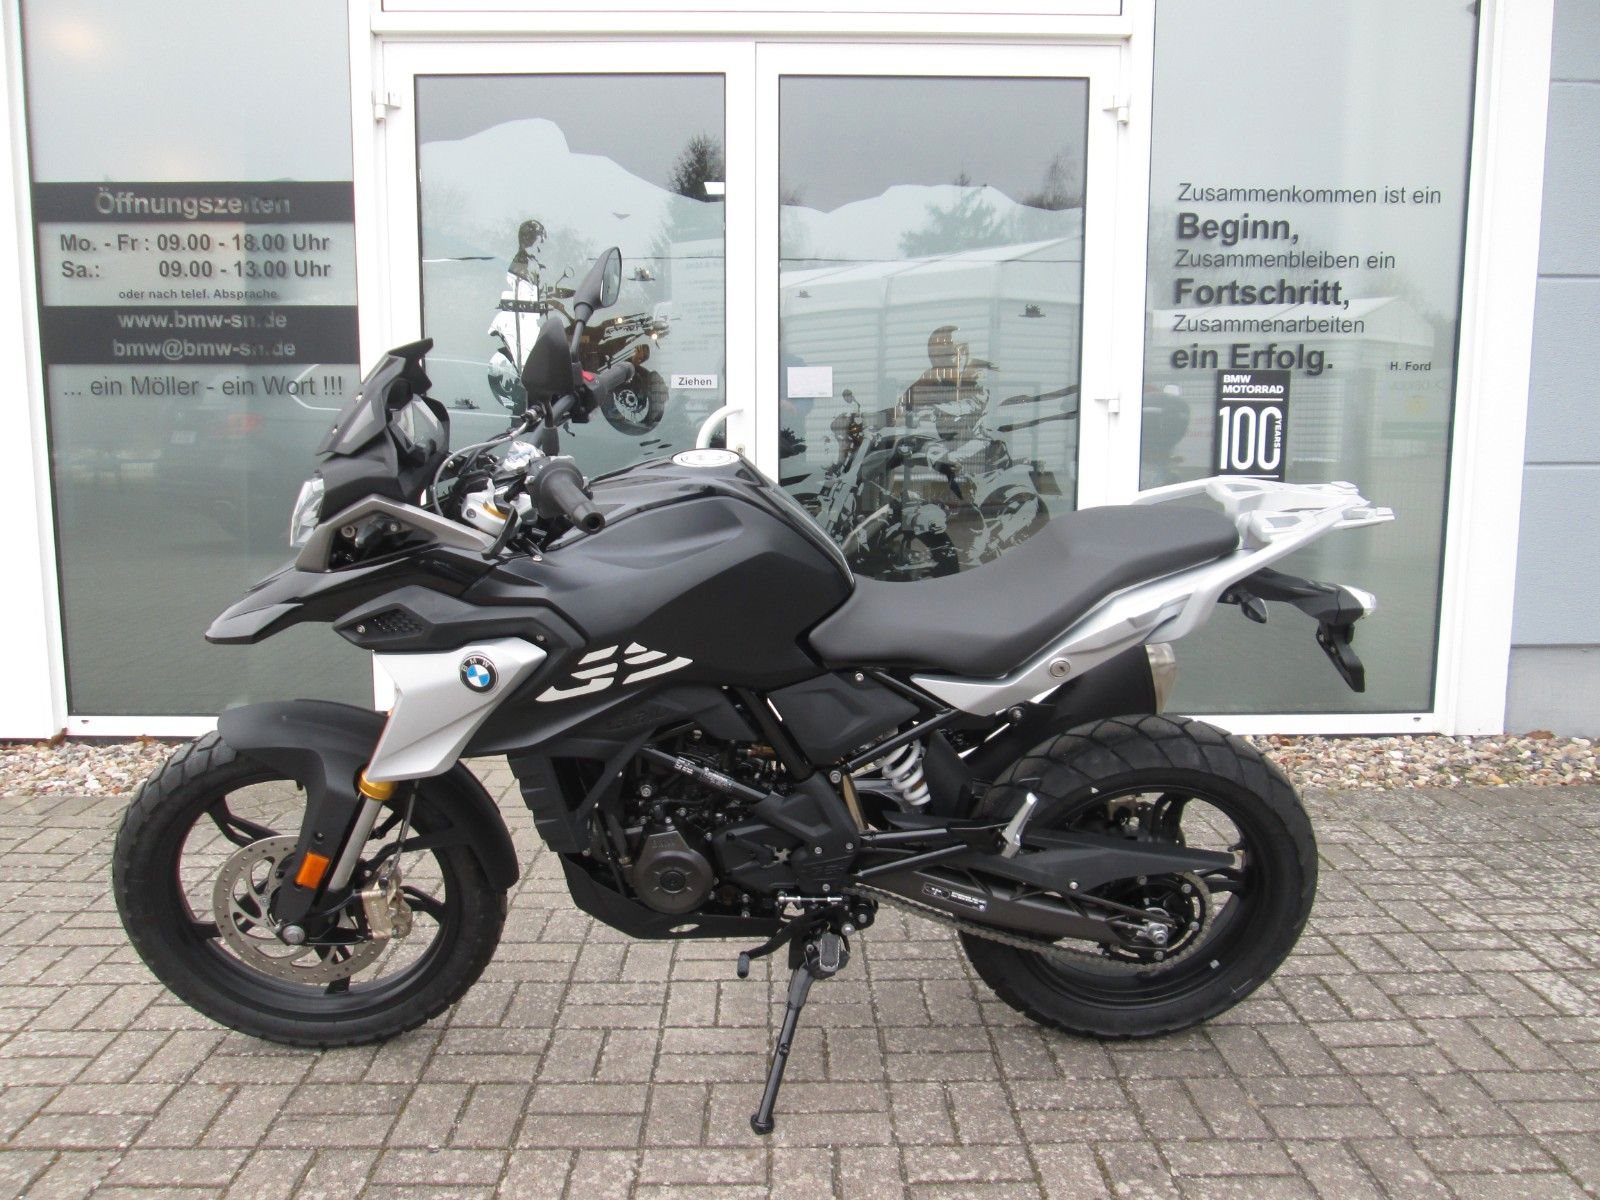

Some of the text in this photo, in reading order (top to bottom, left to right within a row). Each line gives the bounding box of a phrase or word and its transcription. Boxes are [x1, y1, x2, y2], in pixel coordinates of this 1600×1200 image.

[96, 187, 291, 219] Öffnungszeiten
[1178, 183, 1441, 204] Zusammenkommen ist ein
[1176, 212, 1299, 246] Beginn,
[60, 233, 97, 251] Mo.
[157, 233, 211, 251] 09.00
[232, 233, 286, 251] 18.00
[292, 233, 330, 251] Uhr
[1174, 249, 1395, 269] Zusammenbleiben ein
[61, 261, 100, 278] Sa.:
[159, 260, 213, 278] 09.00
[233, 260, 287, 278] 13.00
[293, 260, 331, 278] Uhr
[119, 288, 144, 299] oder
[148, 288, 177, 299] nach
[181, 288, 210, 299] telef.
[1174, 278, 1350, 310] Fortschritt,
[118, 310, 287, 329] www.bmw-sn.de
[1173, 315, 1365, 333] Zusammenarbeiten
[112, 339, 296, 361] bmw@bmw-sn.de
[1170, 344, 1334, 376] ein Erfolg.
[1390, 361, 1432, 371] H. Ford
[90, 377, 122, 396] ein
[131, 375, 199, 396] Möller
[222, 377, 254, 396] ein
[262, 376, 316, 396] Wort
[323, 376, 343, 396] !!!
[678, 377, 712, 386] Ziehen
[1223, 374, 1251, 384] BMW
[1222, 385, 1284, 394] MOTORRAD
[1219, 406, 1283, 471] 100
[1273, 417, 1282, 449] YEARS
[461, 656, 491, 672] BMW
